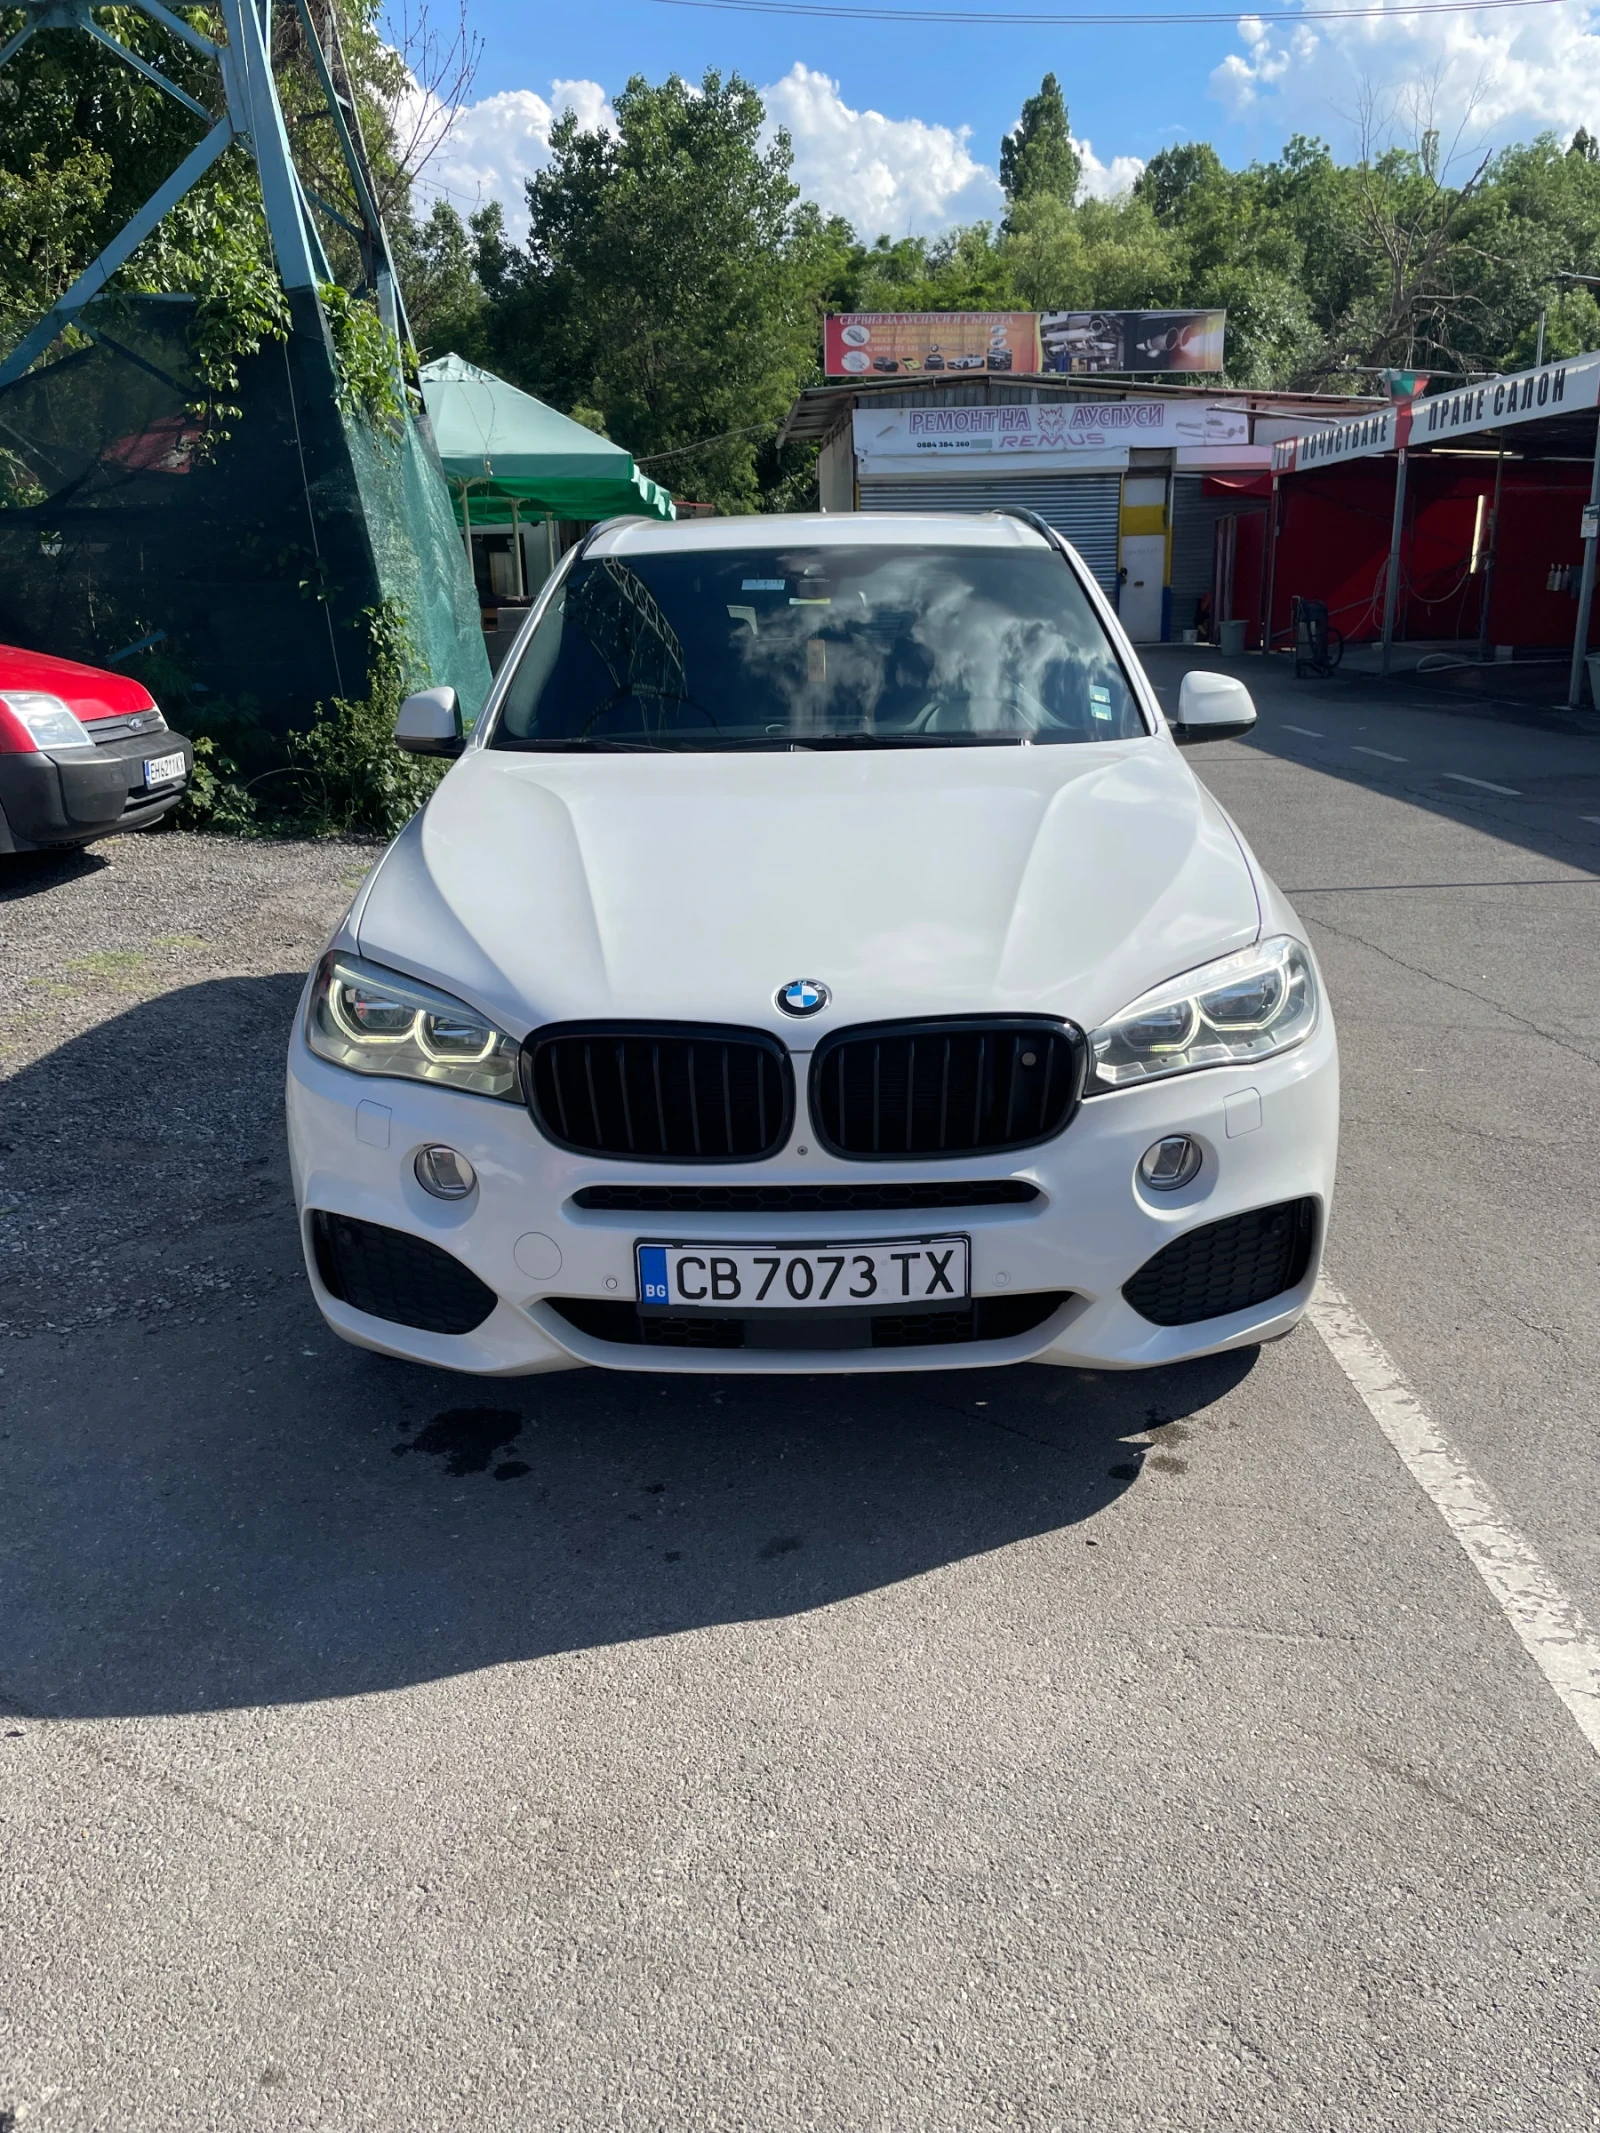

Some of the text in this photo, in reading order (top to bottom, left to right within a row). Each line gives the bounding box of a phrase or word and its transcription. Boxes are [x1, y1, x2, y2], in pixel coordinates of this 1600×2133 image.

[840, 315, 1014, 325] СЕРВИЗ ЗА АУСПУСИ И ГЪРНЕТА
[1428, 368, 1567, 431] ПРАНЕ САЛОН
[909, 403, 1164, 434] РЕМОНТ НА АУСПУСИ
[917, 441, 937, 449] 0884
[955, 440, 970, 448] 260
[999, 433, 1105, 448] REMUS
[1302, 415, 1387, 461] ПОЧИСТВАНЕ
[753, 1255, 877, 1300] 7073
[646, 1284, 666, 1297] BG
